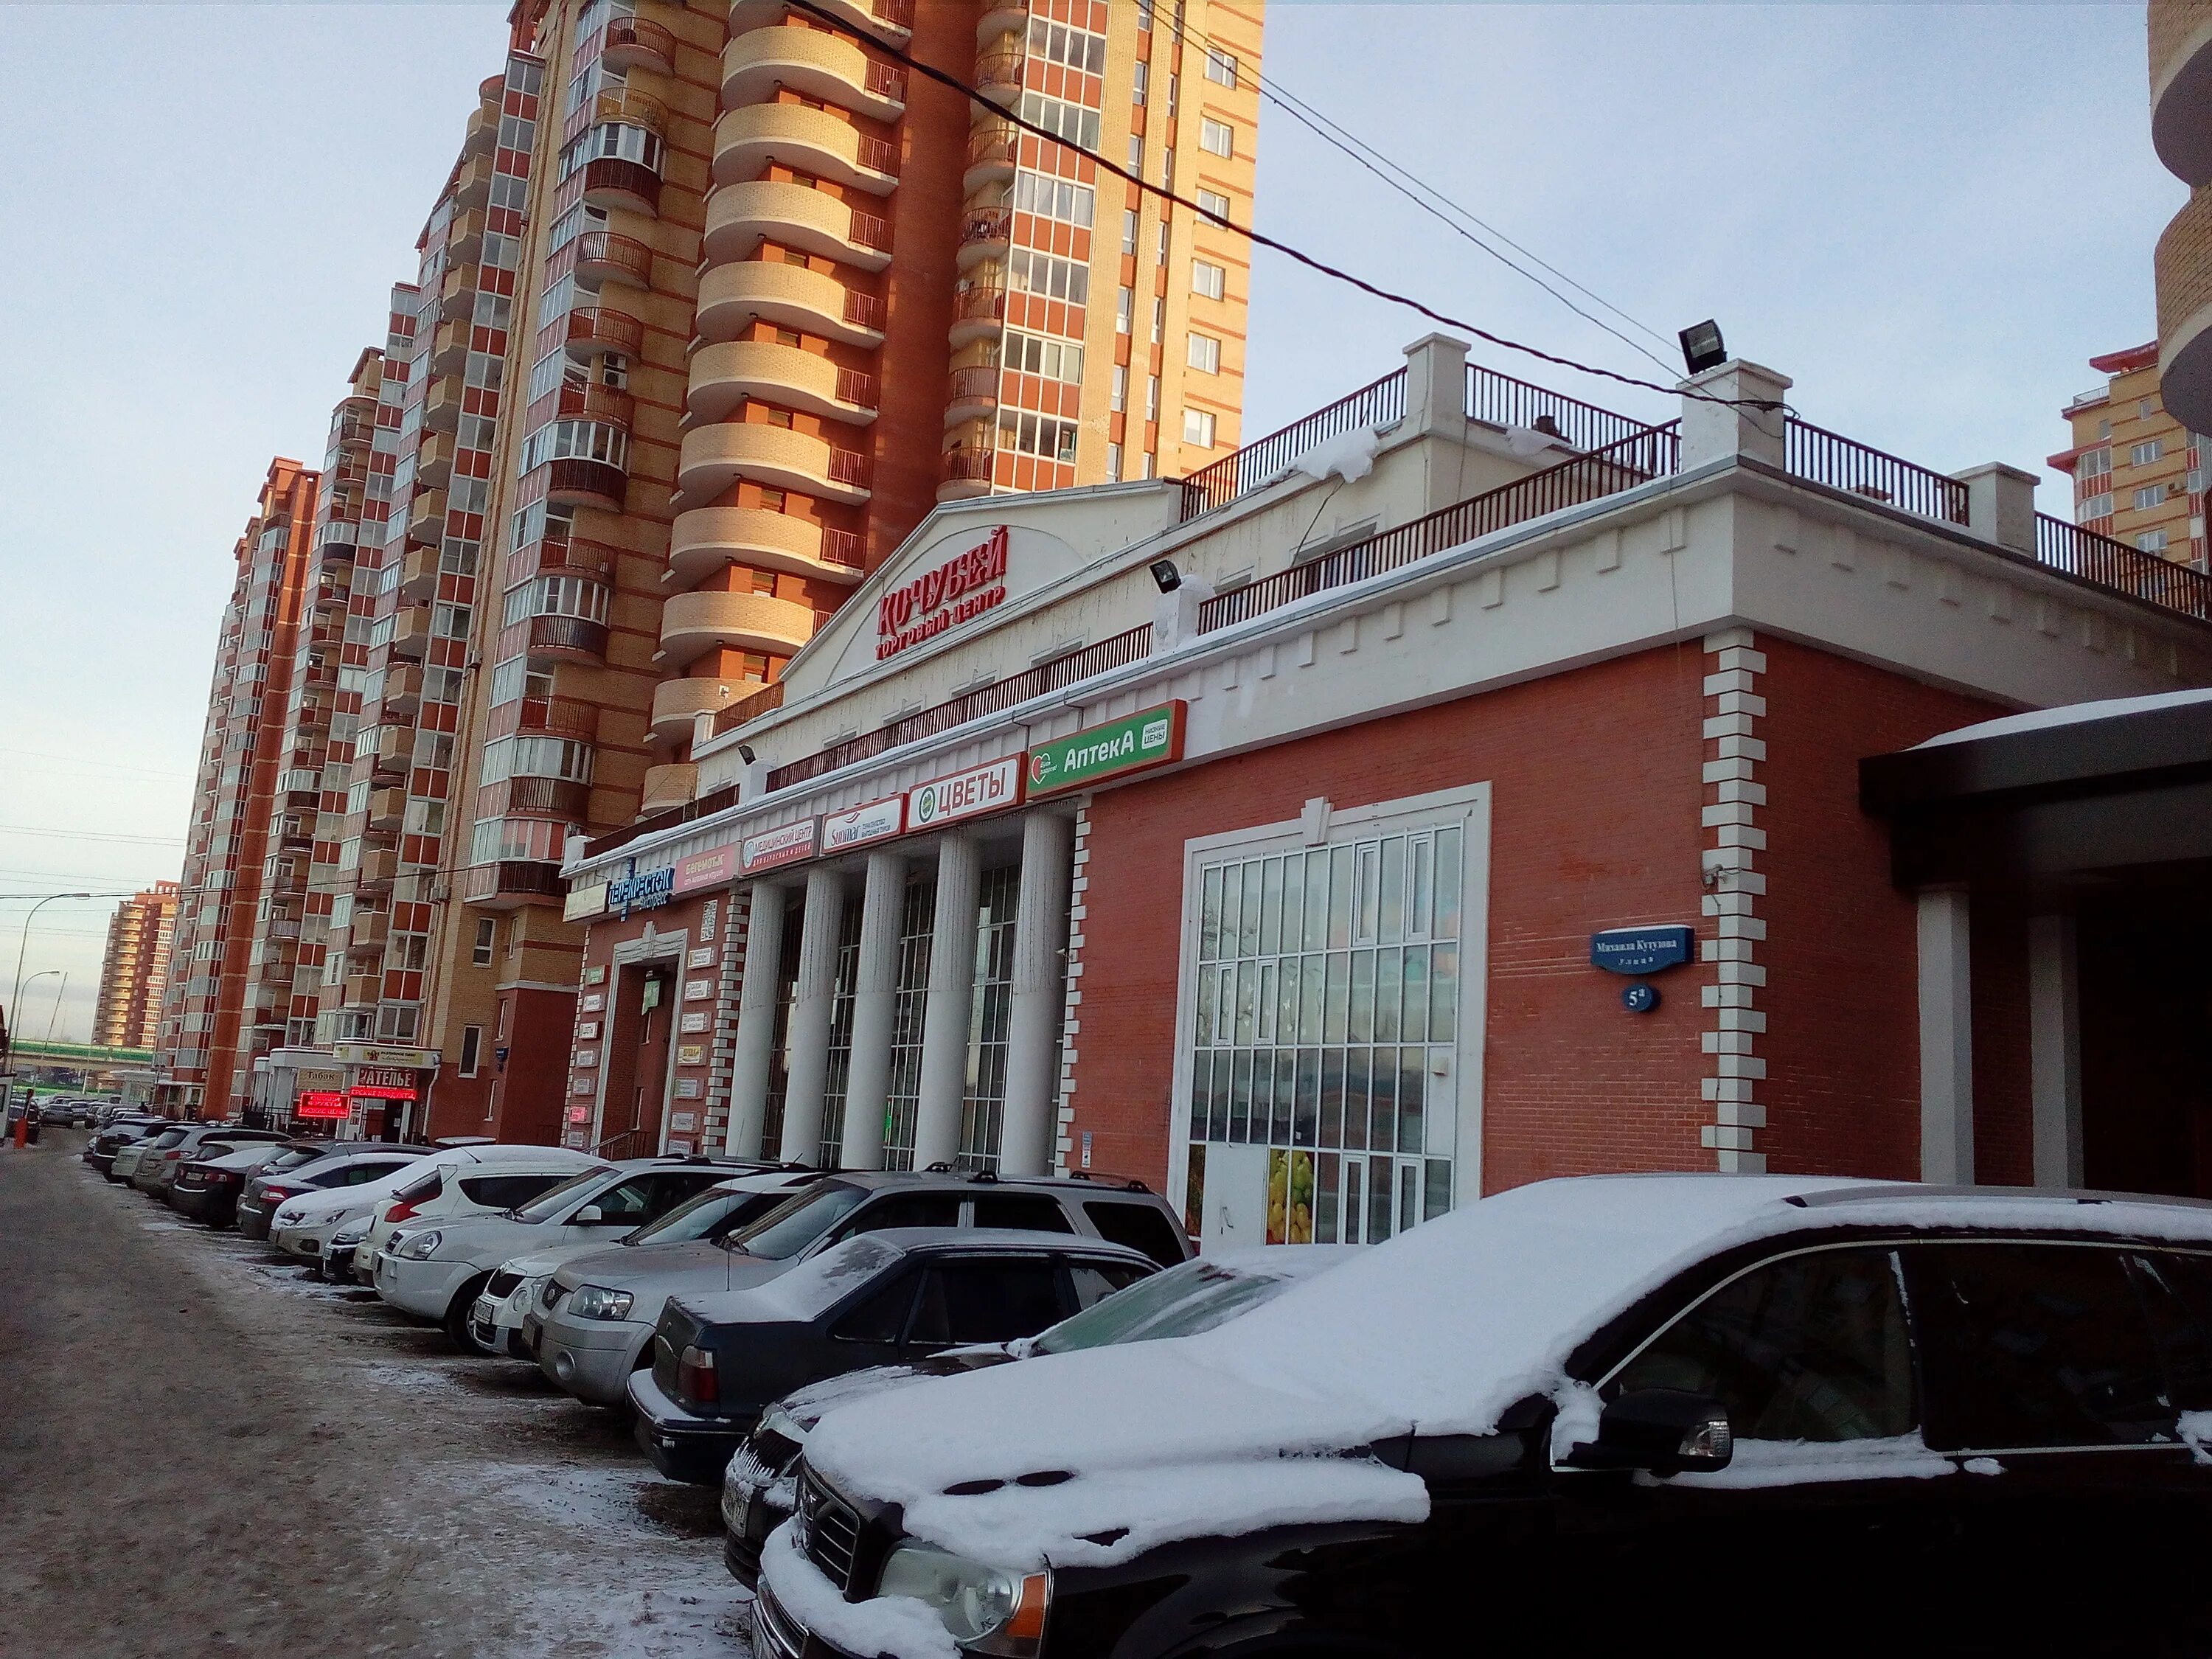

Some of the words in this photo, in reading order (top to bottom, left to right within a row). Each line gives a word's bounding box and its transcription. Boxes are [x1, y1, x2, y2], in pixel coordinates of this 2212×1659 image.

[877, 524, 1009, 636] КОЧУБЕЙ
[875, 609, 950, 661] ТОРГОВЫЙ
[952, 585, 1006, 625] ЦЕНТР
[1144, 731, 1166, 745] ЦЕНЫ
[938, 767, 1006, 816] ЦВЕТЫ
[754, 829, 795, 852] МЕДИЦИНСКИЙ
[795, 825, 812, 842] ЦЕНТР
[830, 825, 860, 846] Sunmar
[1596, 942, 1635, 953] Михаила
[1636, 939, 1677, 952] Кутузова
[307, 1071, 335, 1080] Табак
[366, 1068, 411, 1088] АТЕЛЬЕ
